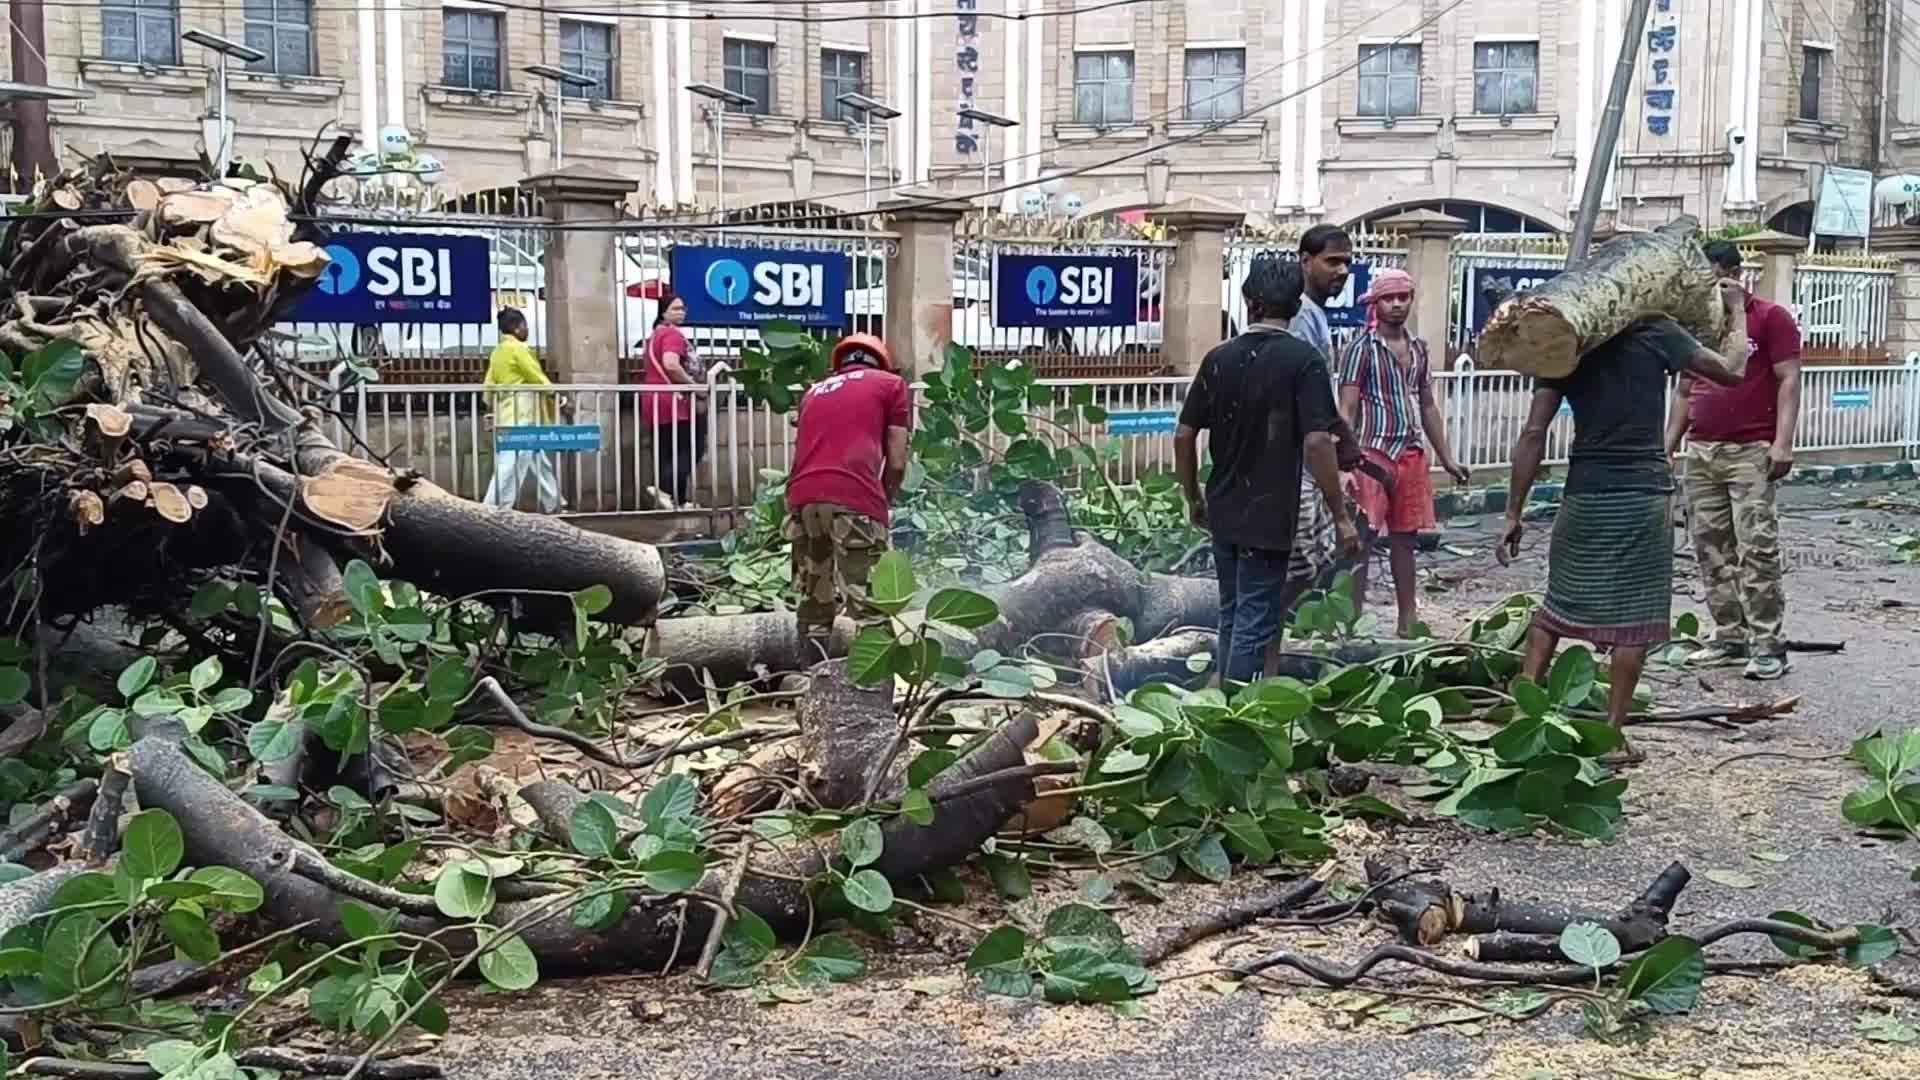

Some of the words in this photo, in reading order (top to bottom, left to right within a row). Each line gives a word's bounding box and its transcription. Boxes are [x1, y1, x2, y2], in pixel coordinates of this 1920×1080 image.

[366, 246, 451, 296] SBI
[753, 261, 823, 306] SBI
[1060, 265, 1113, 304] SBI
